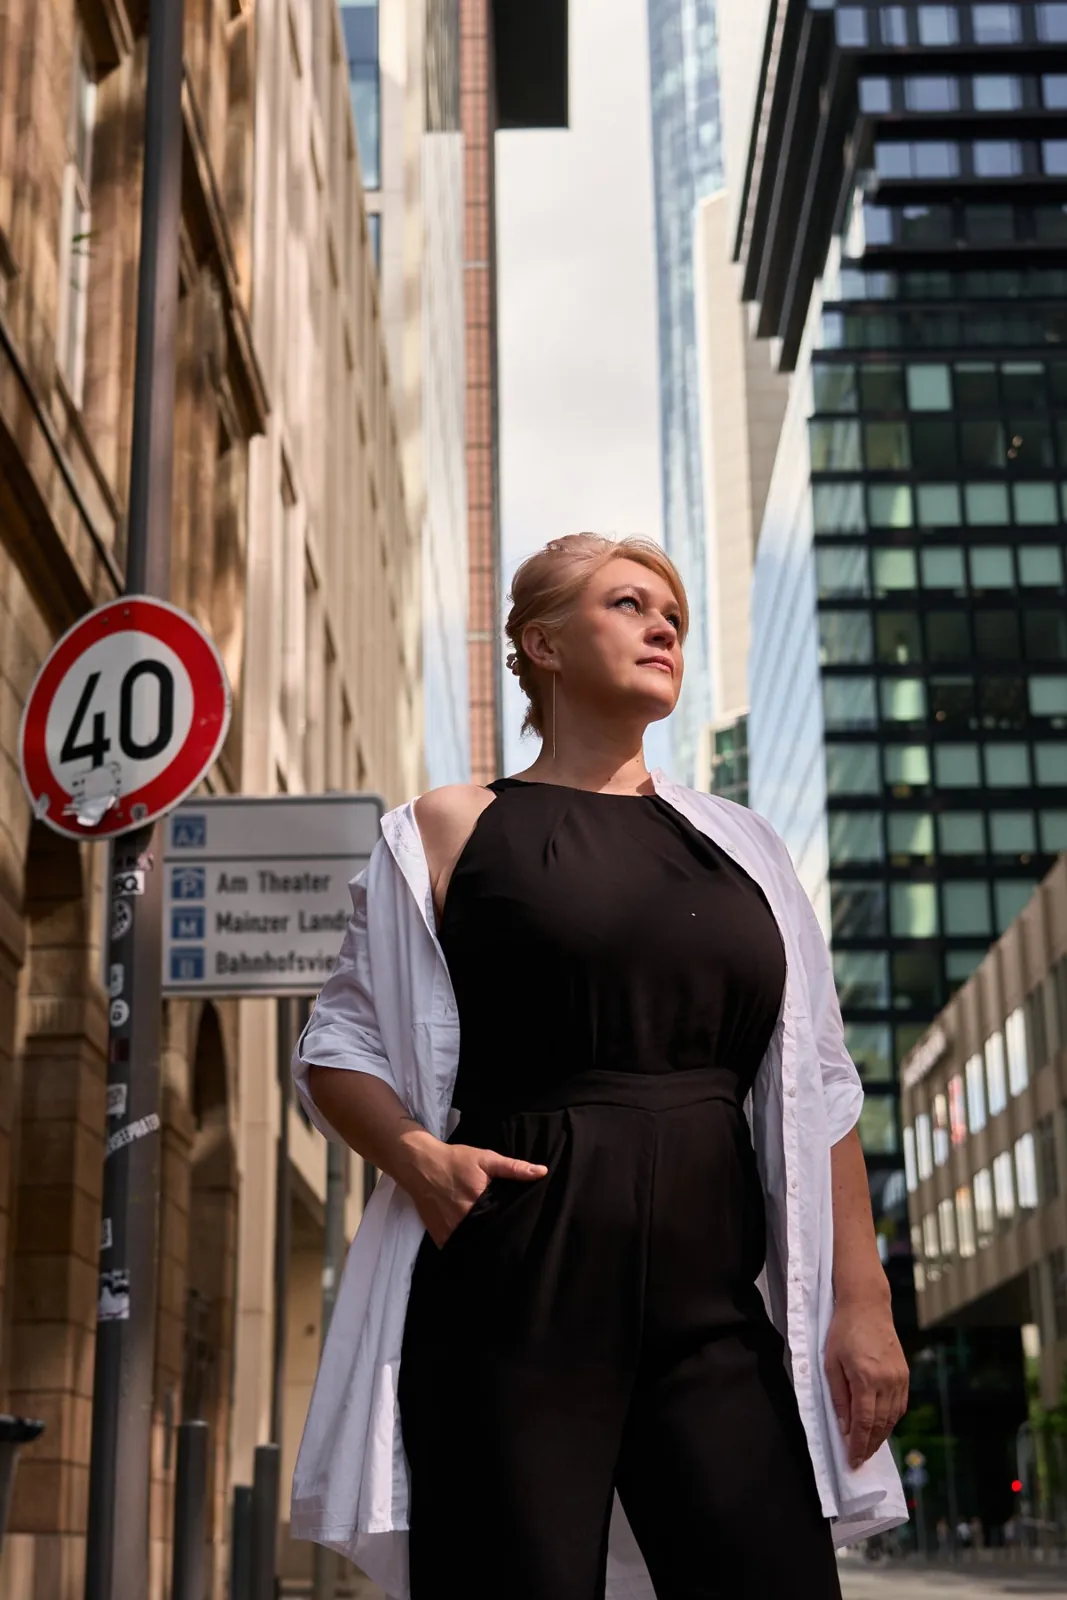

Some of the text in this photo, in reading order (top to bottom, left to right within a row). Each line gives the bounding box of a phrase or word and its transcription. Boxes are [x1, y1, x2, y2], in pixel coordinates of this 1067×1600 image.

[60, 659, 174, 769] 40
[217, 872, 247, 894] Am
[258, 869, 331, 893] Theater
[216, 911, 290, 933] Mainzer
